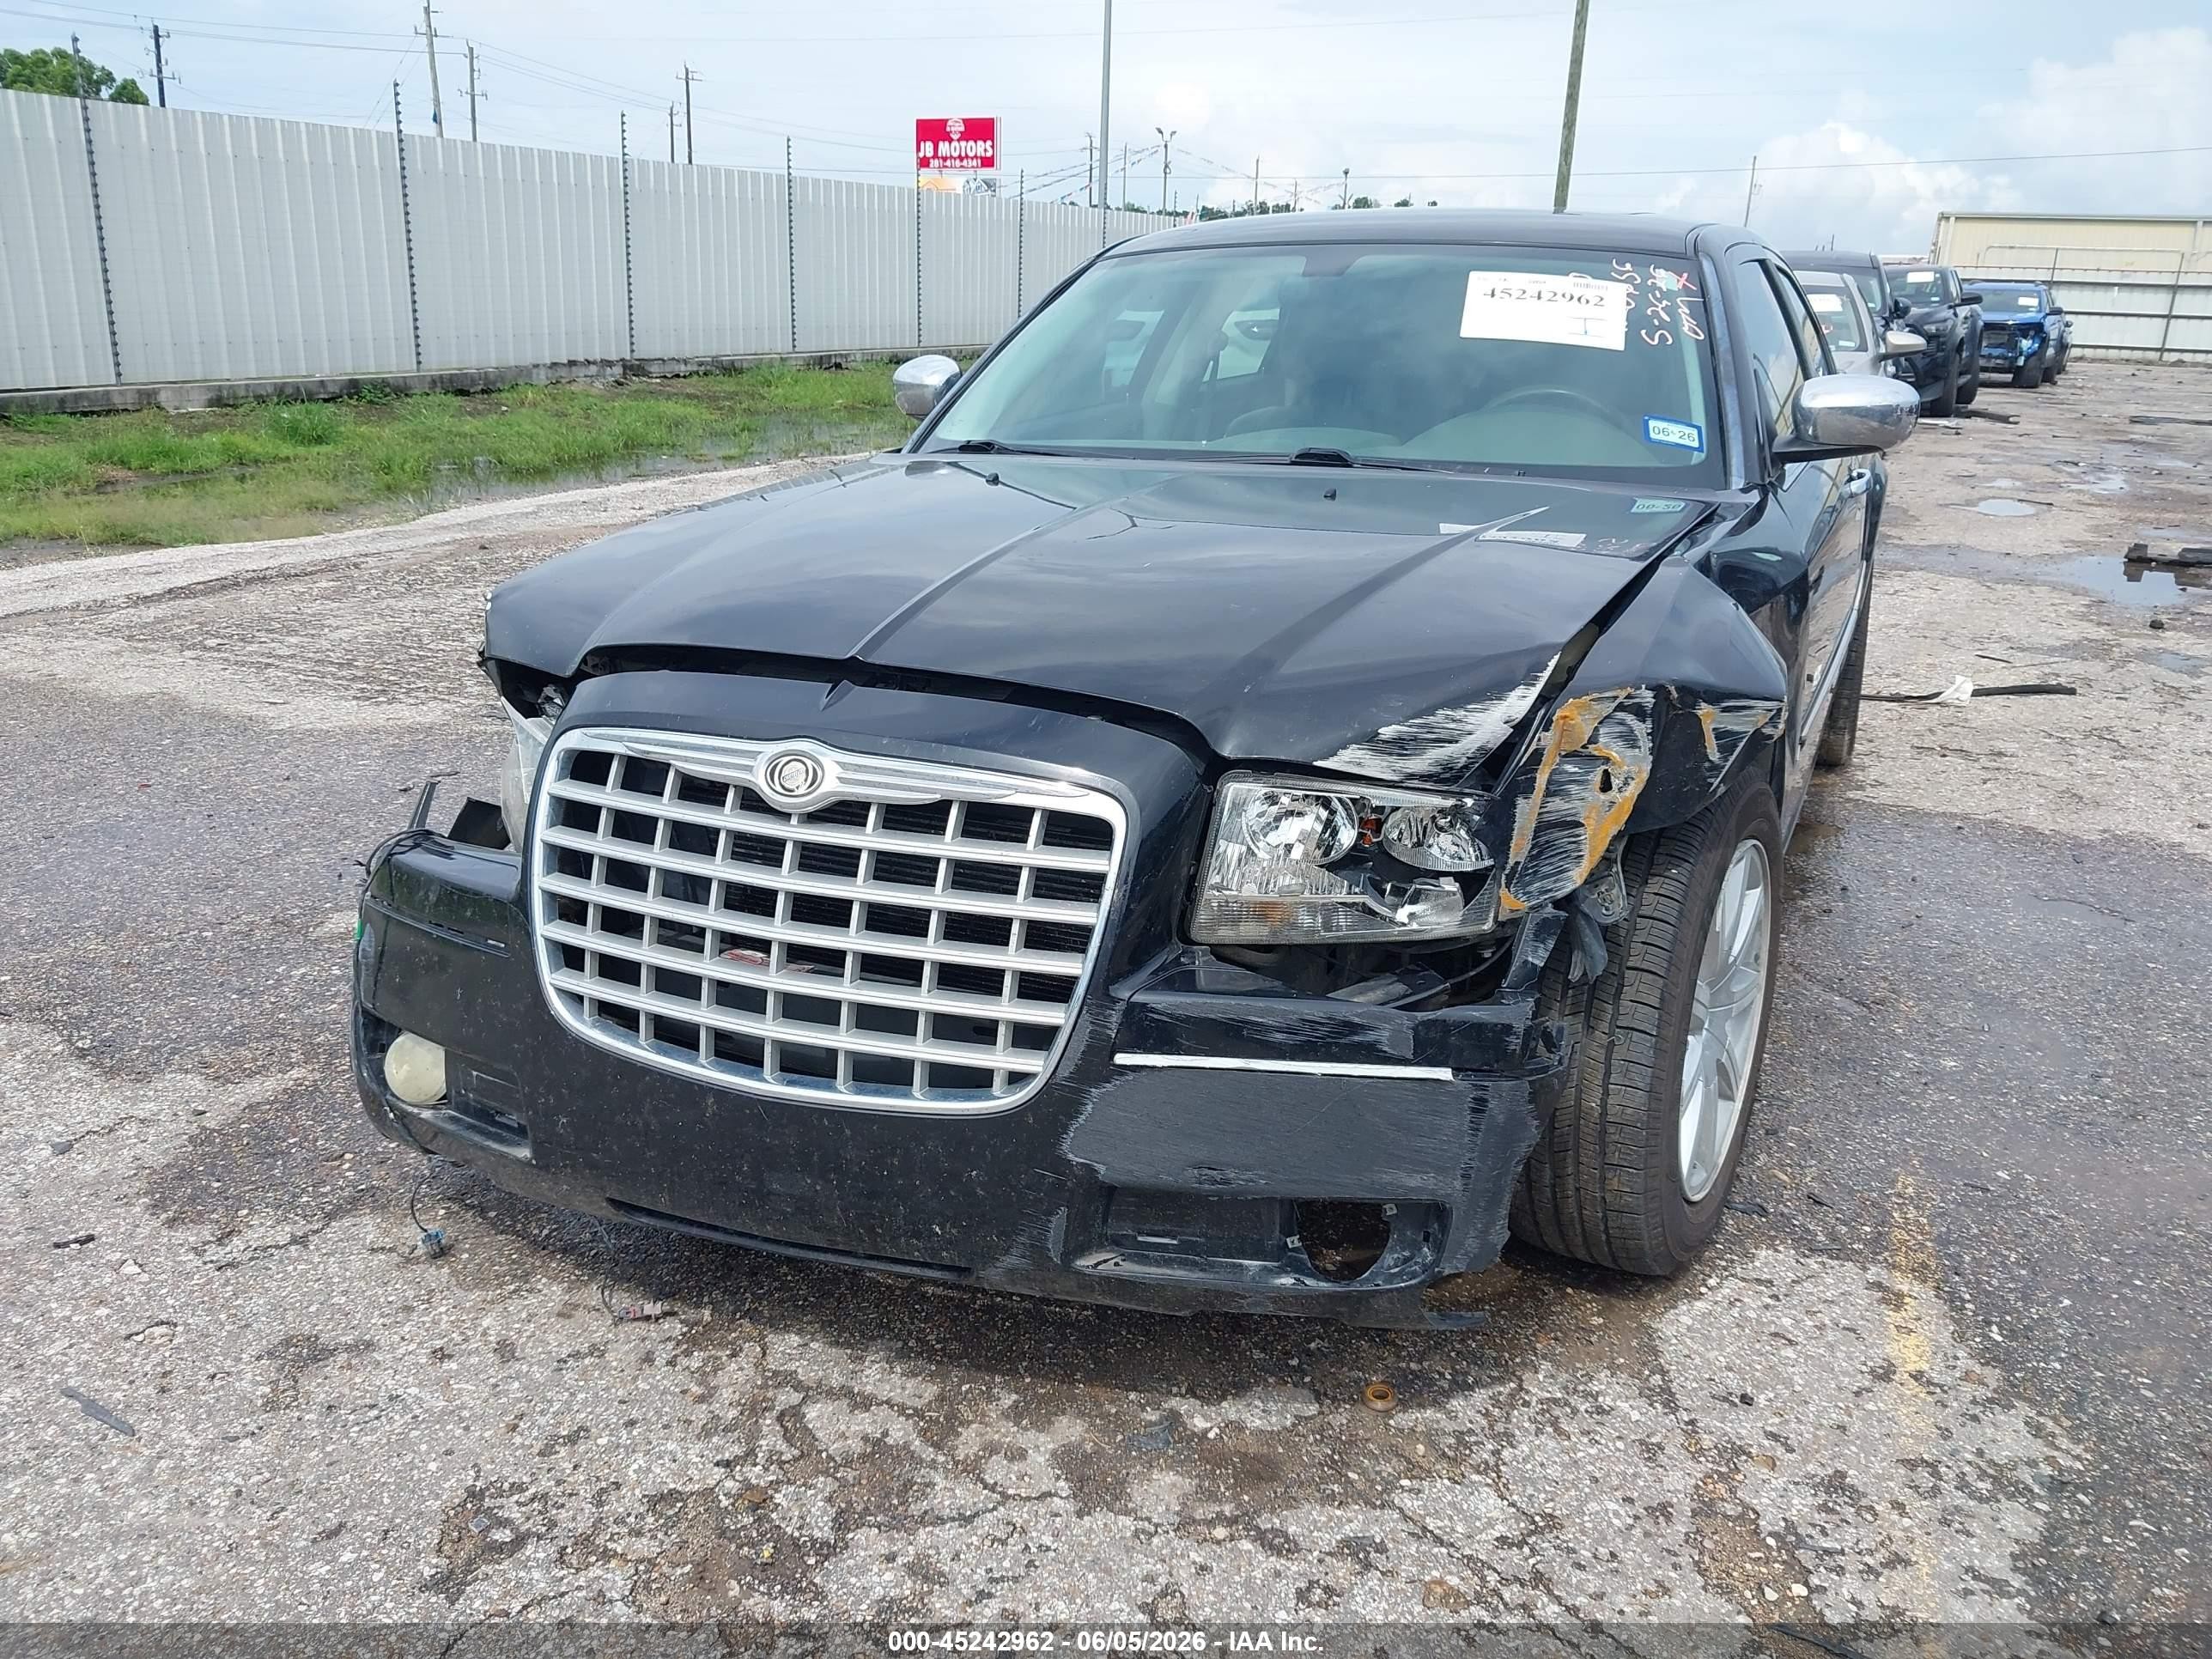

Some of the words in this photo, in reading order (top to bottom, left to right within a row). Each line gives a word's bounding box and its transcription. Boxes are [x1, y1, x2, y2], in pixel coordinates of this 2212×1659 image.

[918, 140, 934, 157] JB
[938, 140, 993, 157] MOTORS
[1483, 287, 1605, 307] 45242962
[1652, 426, 1696, 442] 06-26
